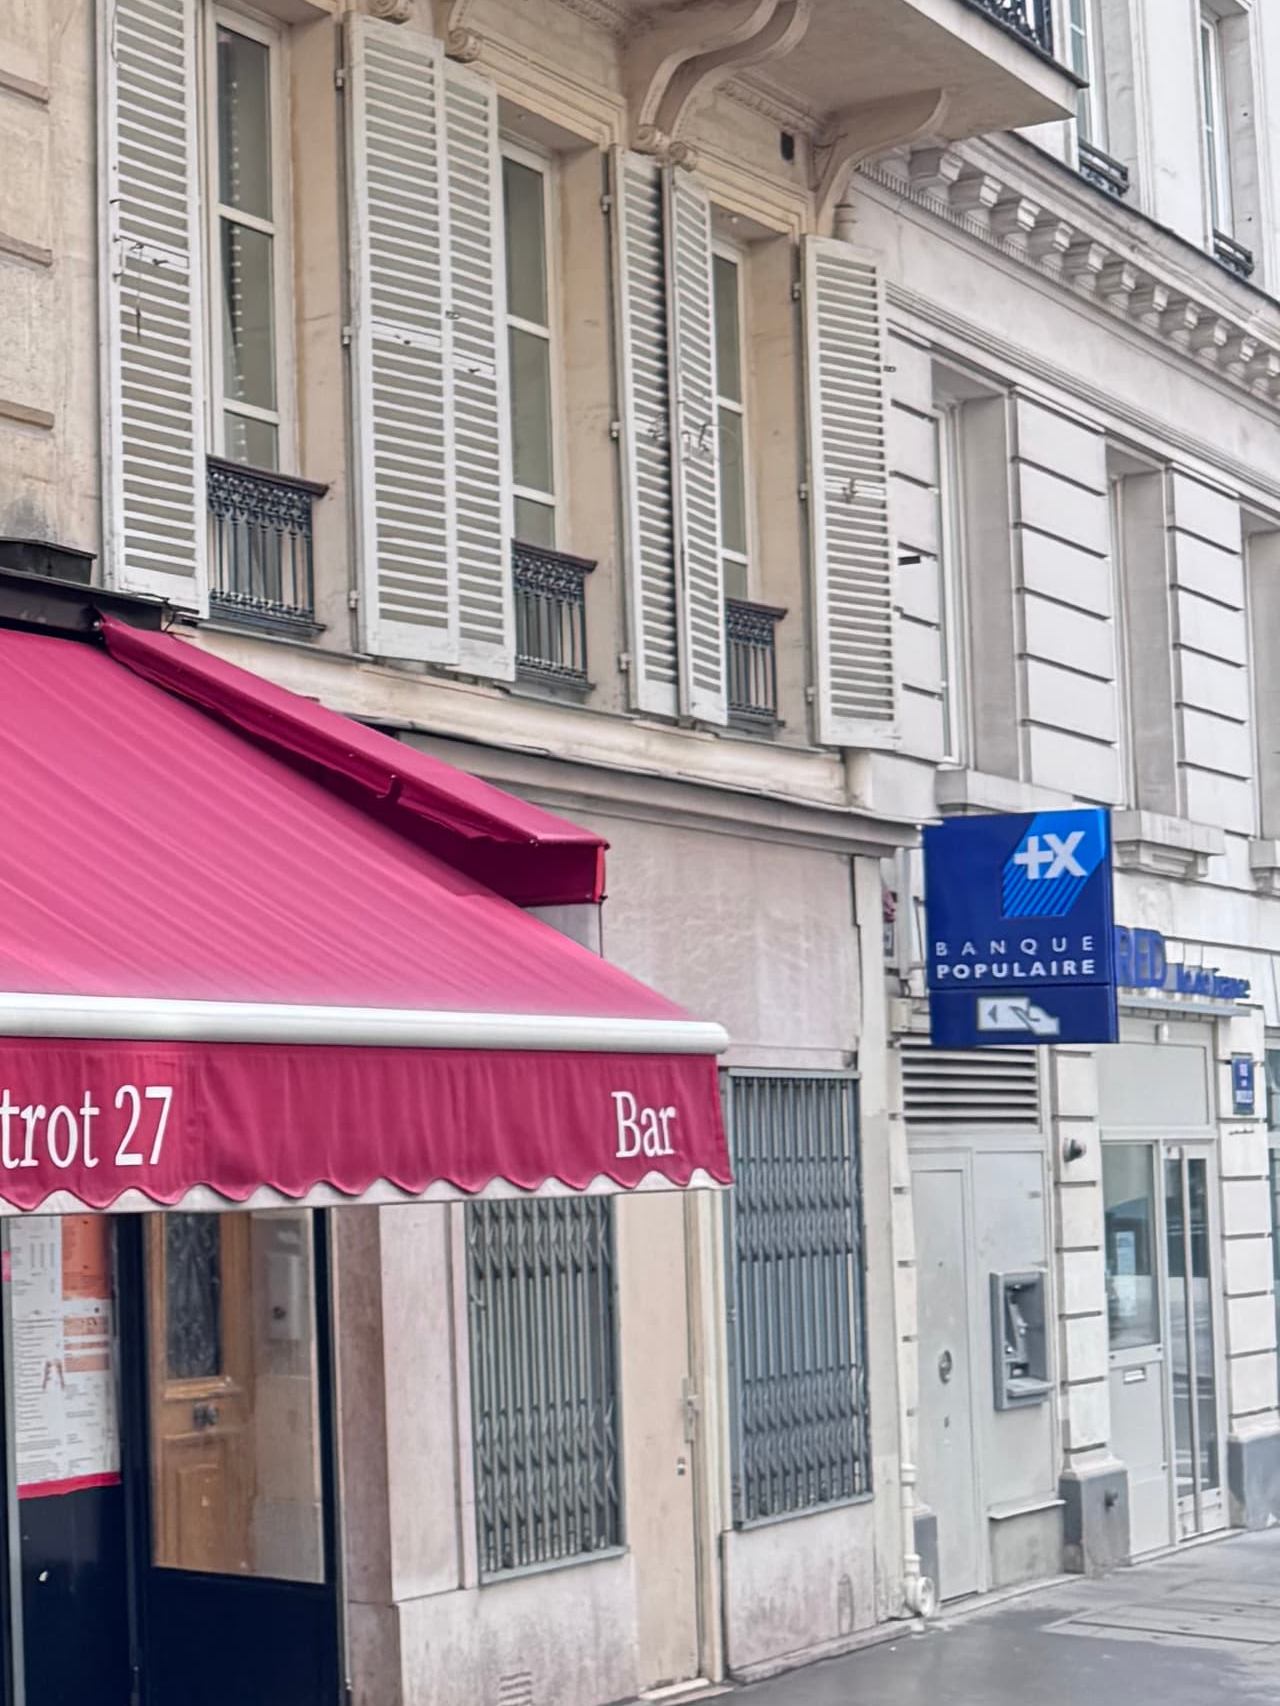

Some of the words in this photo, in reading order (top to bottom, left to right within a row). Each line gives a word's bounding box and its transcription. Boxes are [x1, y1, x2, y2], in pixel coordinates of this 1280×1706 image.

[935, 935, 1094, 957] BANQUE
[936, 959, 1095, 980] POPULAIRE
[113, 1084, 174, 1167] 27
[611, 1090, 678, 1160] Bar
